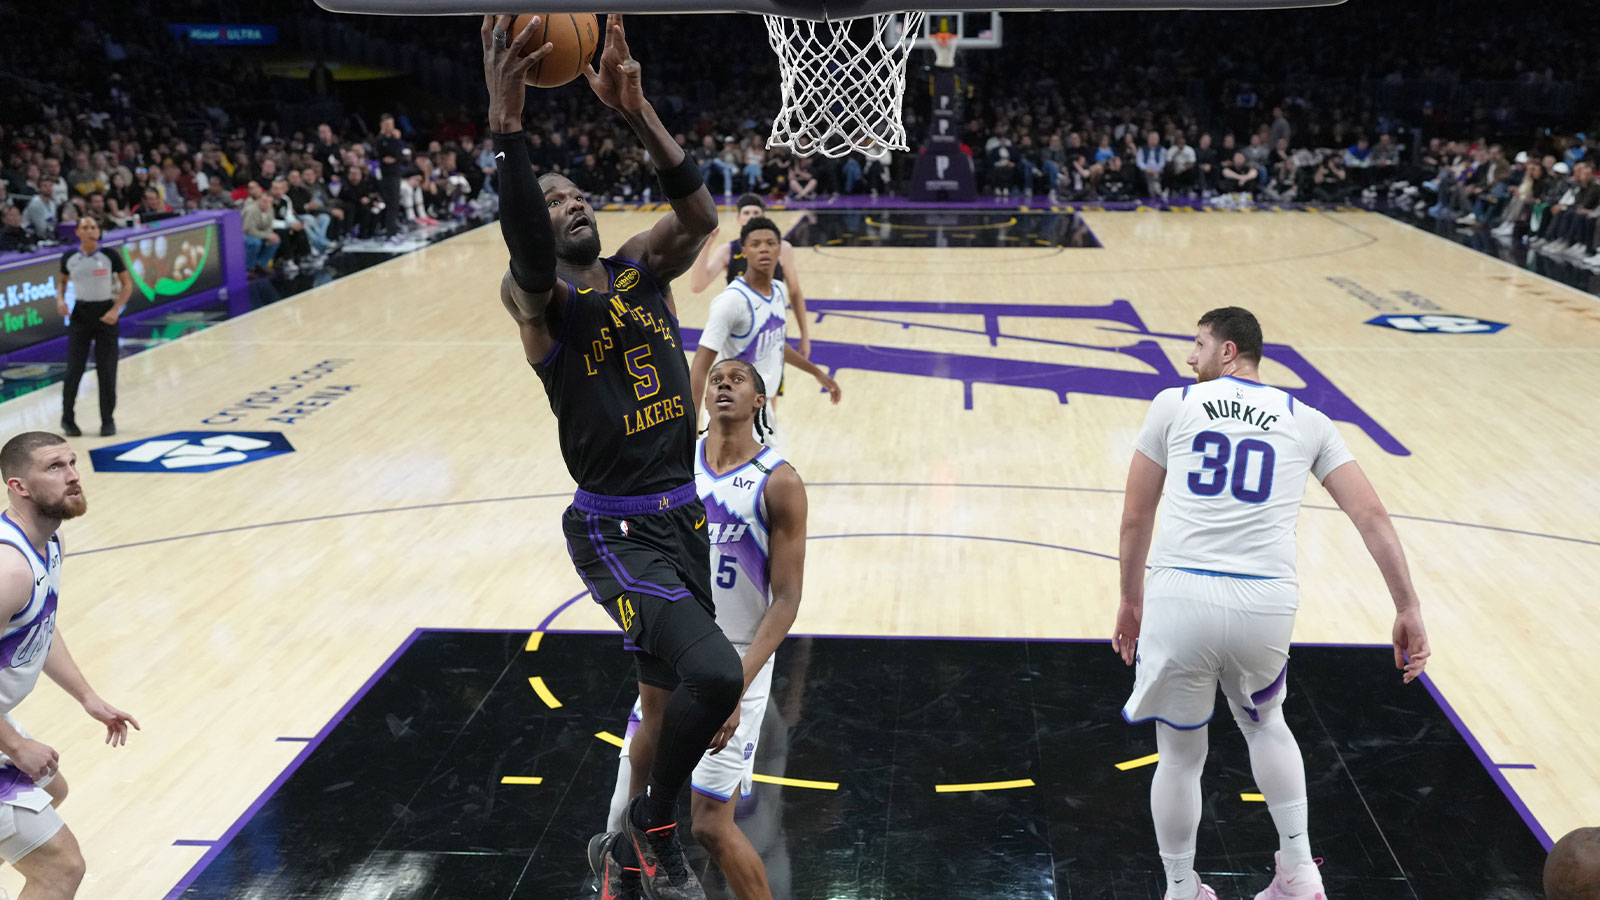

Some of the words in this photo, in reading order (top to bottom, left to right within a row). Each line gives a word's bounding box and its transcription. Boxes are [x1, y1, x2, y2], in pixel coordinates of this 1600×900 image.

[615, 270, 637, 289] bibigo
[583, 327, 614, 376] LOS
[609, 294, 676, 348] ANGELES
[624, 343, 661, 400] 5
[624, 395, 684, 436] LAKERS
[1202, 399, 1280, 431] NURKIĆ
[732, 476, 756, 490] LVT
[1187, 430, 1276, 505] 30
[716, 554, 737, 589] 5
